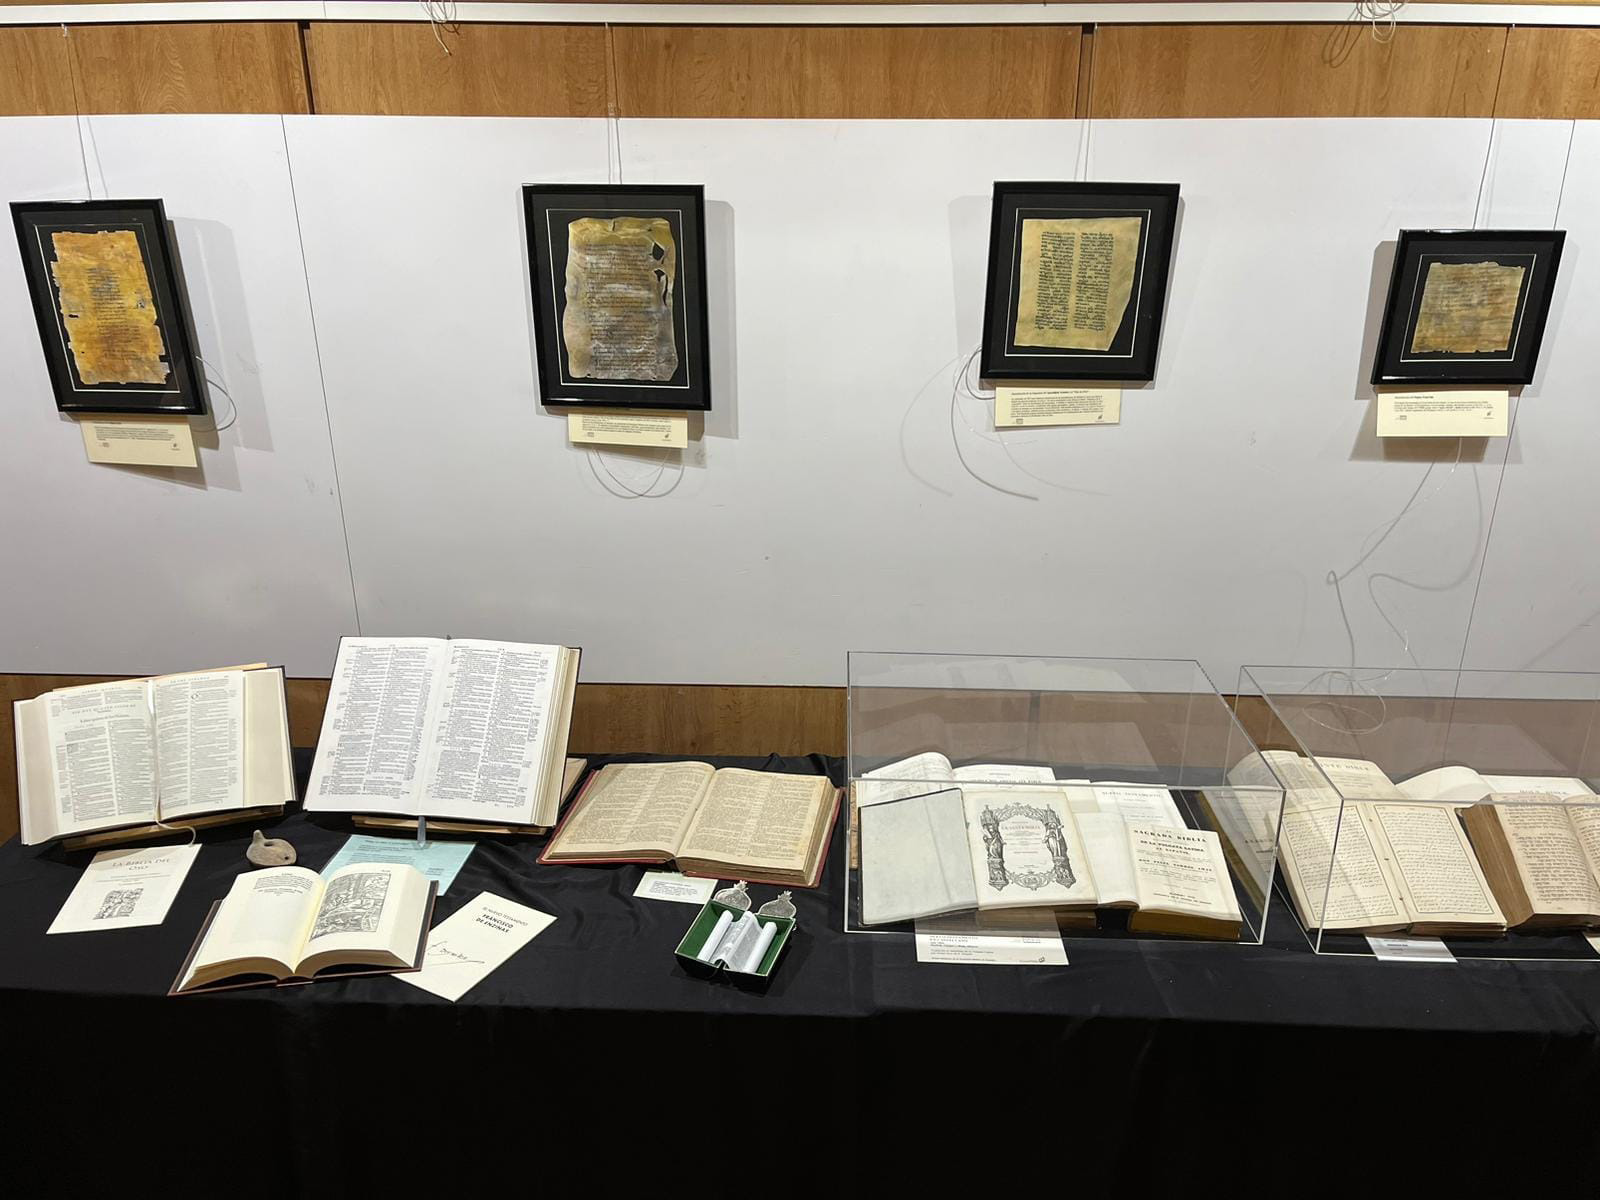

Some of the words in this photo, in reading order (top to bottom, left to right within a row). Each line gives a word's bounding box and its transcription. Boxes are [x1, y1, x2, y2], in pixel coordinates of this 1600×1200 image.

[1176, 835, 1207, 843] BIBLIA
[481, 913, 514, 929] FRANCISCO
[483, 920, 510, 933] ENZINAS
